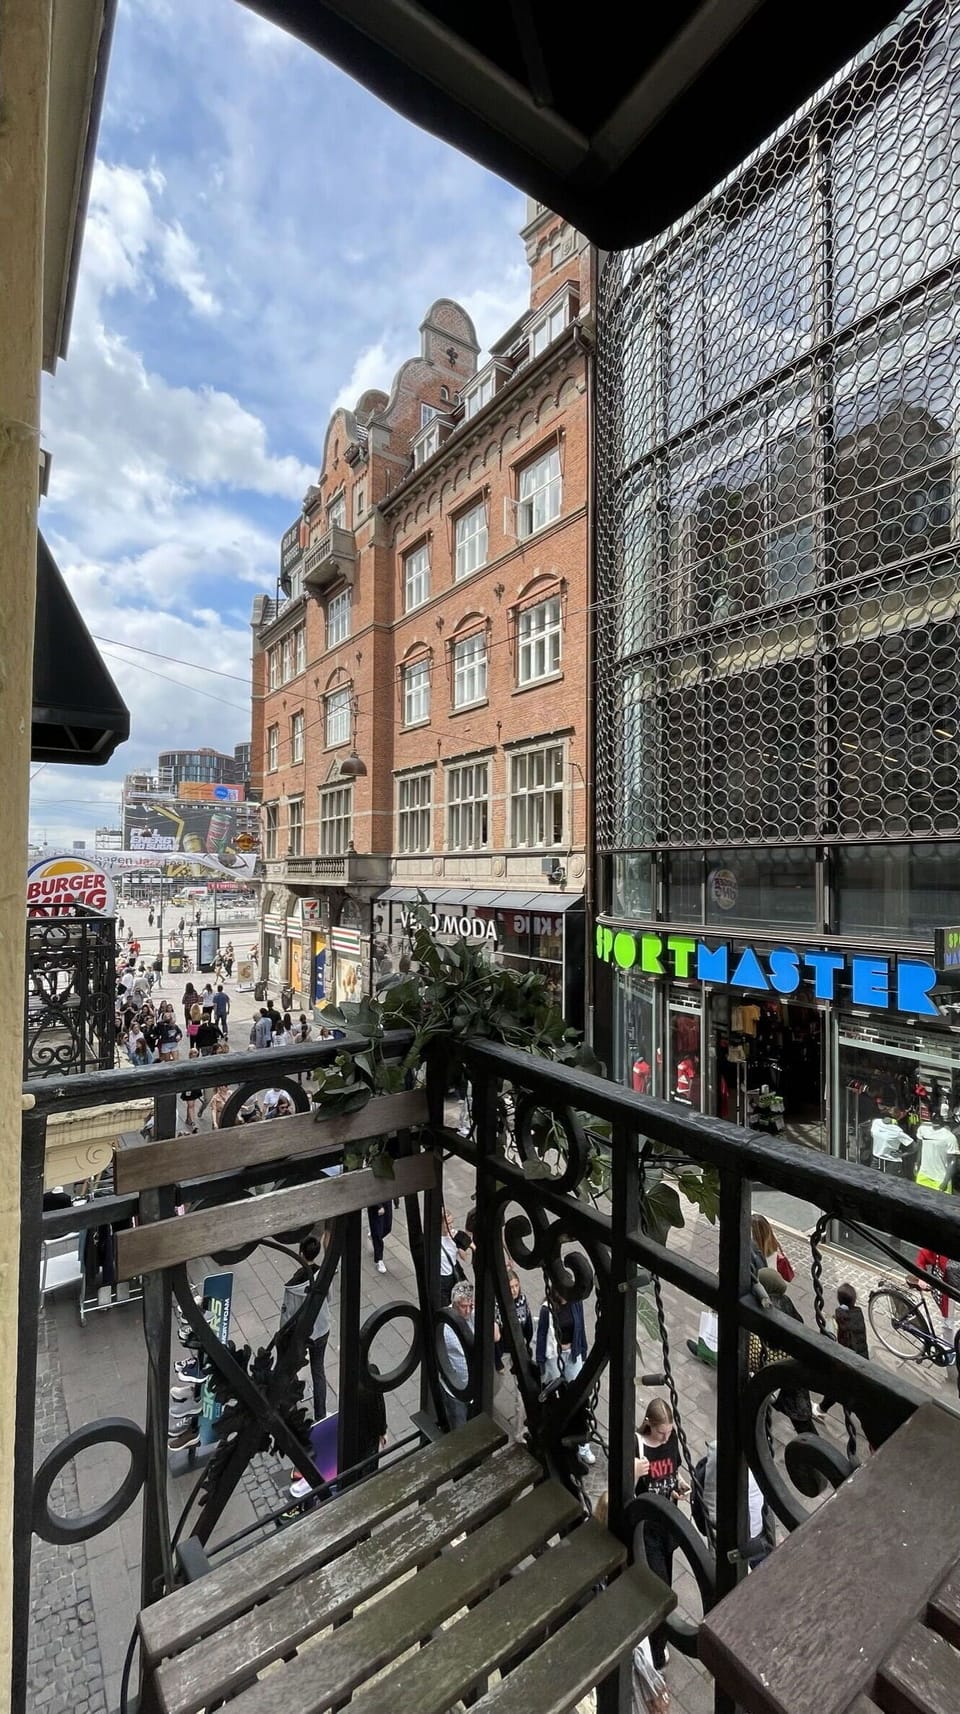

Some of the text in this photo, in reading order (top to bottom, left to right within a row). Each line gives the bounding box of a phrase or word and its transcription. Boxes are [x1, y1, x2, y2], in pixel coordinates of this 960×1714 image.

[28, 875, 105, 900] BURGER
[400, 911, 498, 941] VEO MODA
[596, 924, 941, 1016] SPORTMASTER
[650, 1457, 674, 1479] KISS
